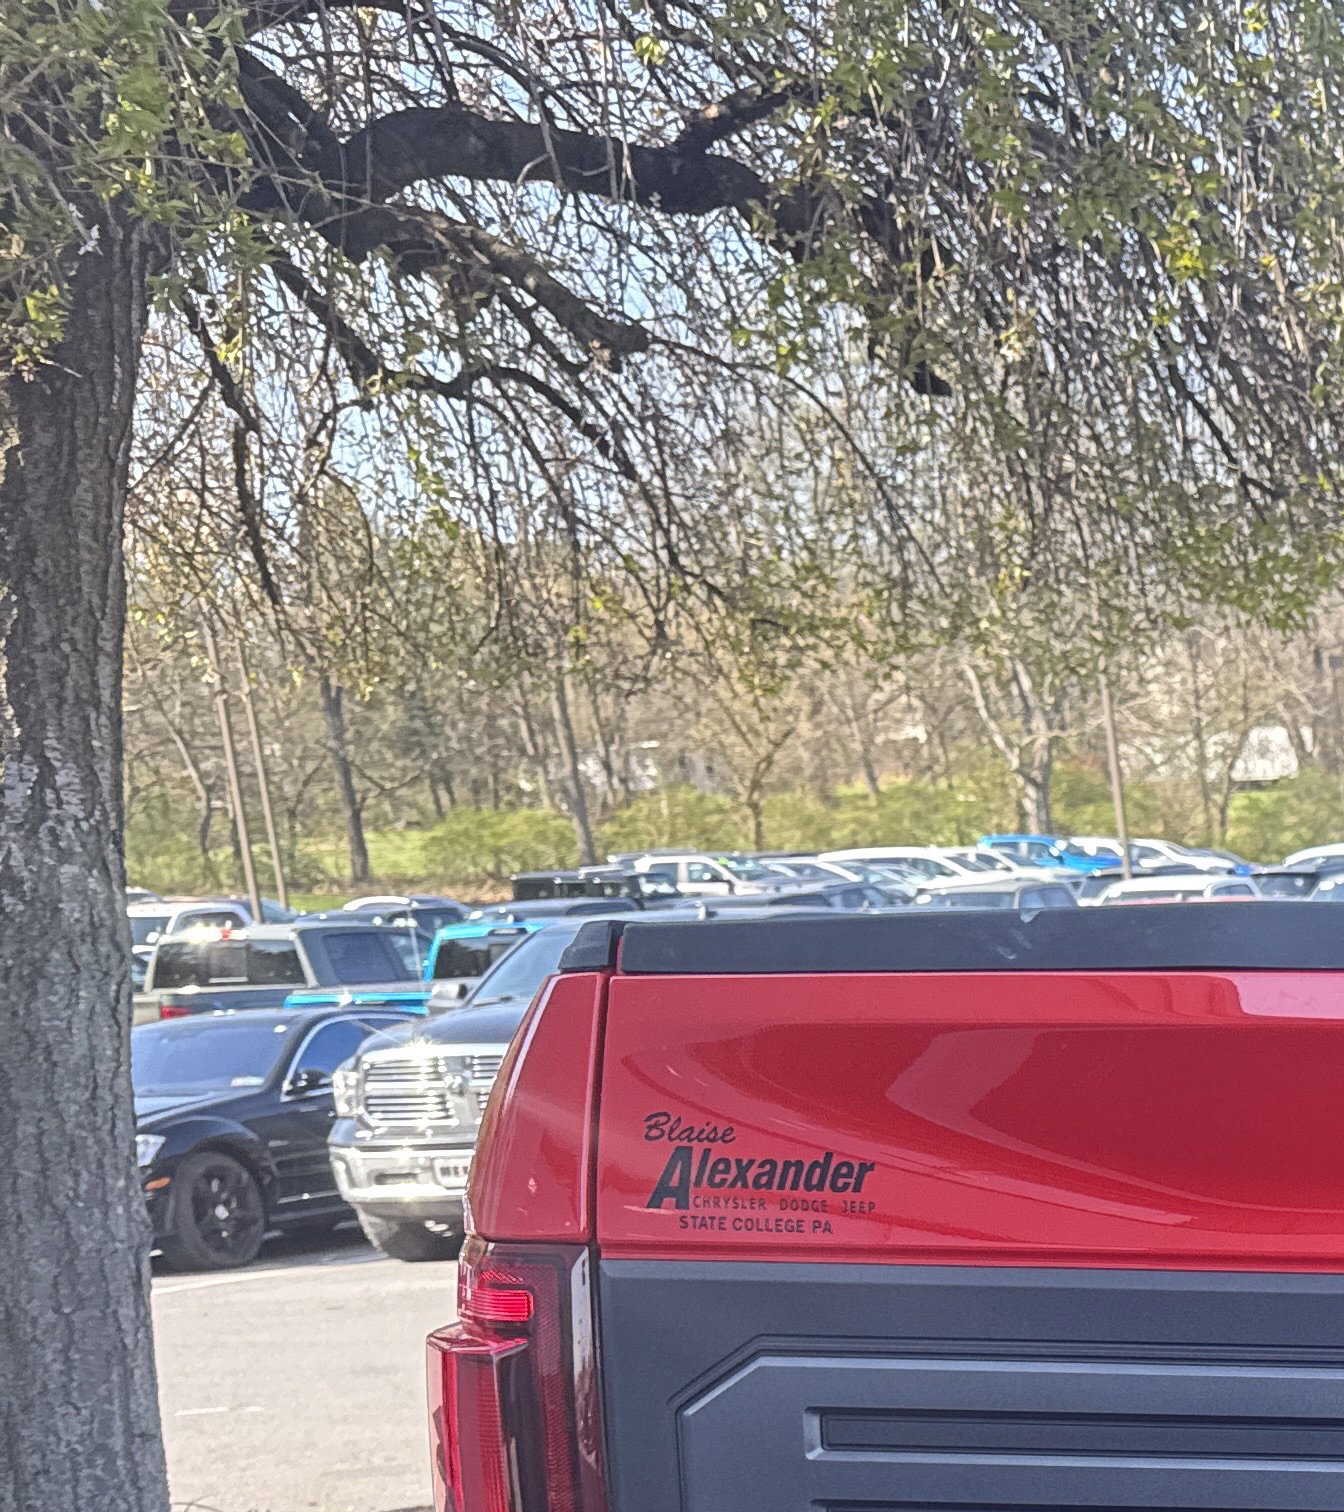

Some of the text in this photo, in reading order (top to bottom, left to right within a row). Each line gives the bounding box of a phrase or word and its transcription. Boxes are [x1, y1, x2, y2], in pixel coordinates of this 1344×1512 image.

[643, 1111, 736, 1143] Blaise
[646, 1146, 875, 1210] Alexander
[692, 1195, 876, 1214] CHRYSLER DODGE JEEP
[679, 1215, 833, 1234] STATE COLLEGE PA
